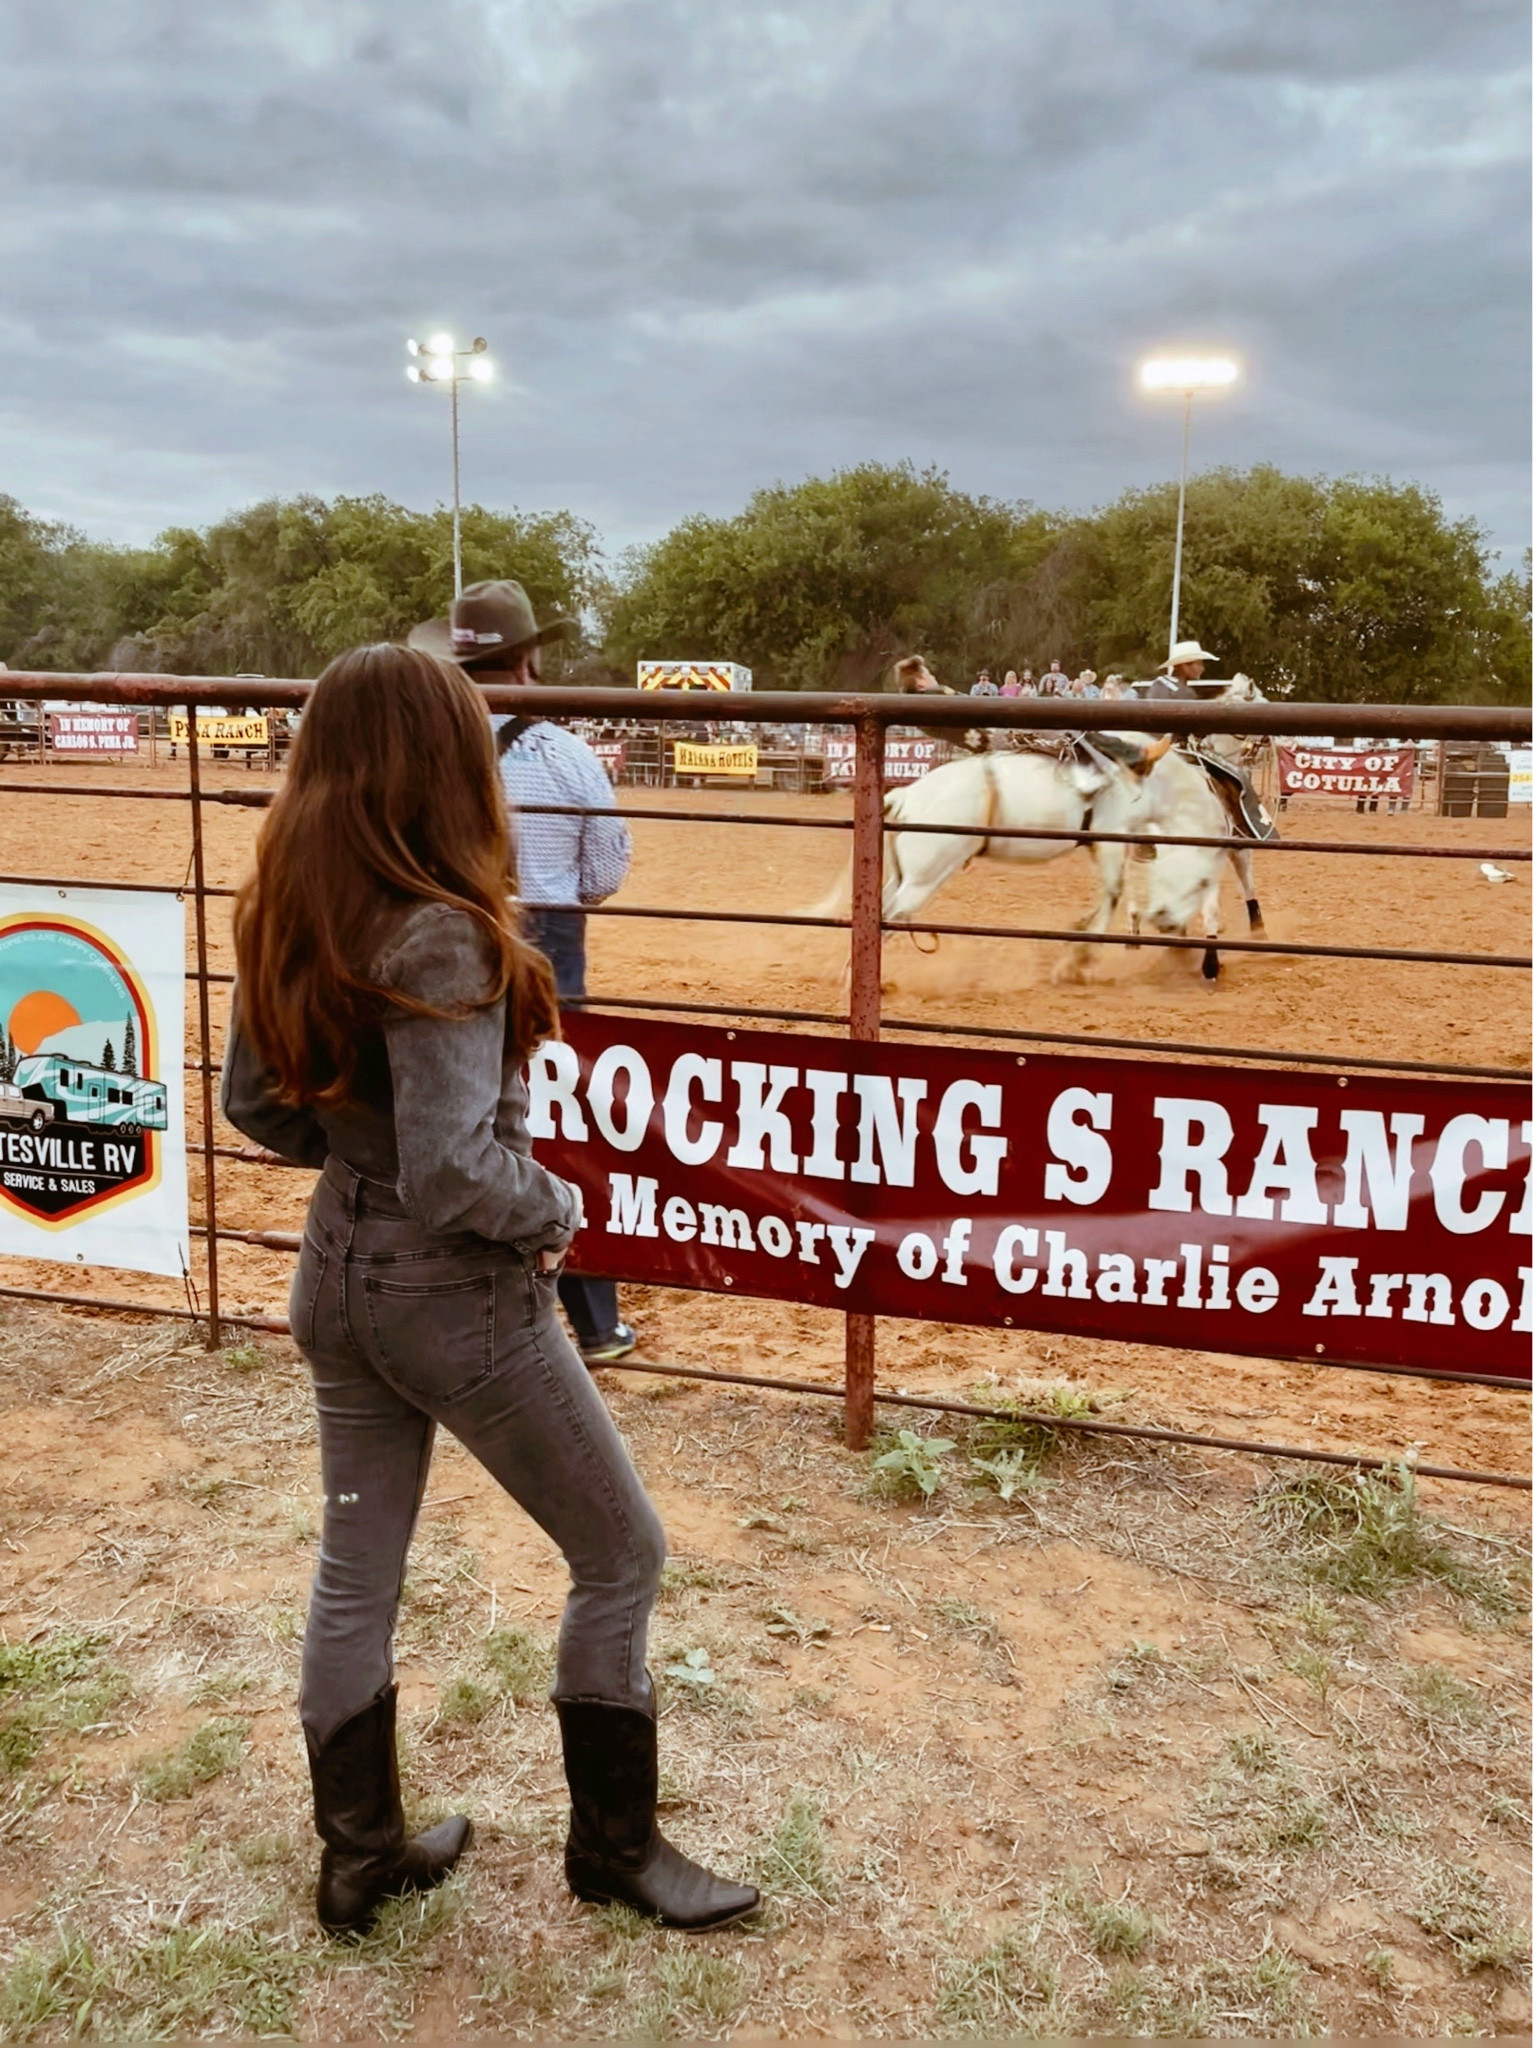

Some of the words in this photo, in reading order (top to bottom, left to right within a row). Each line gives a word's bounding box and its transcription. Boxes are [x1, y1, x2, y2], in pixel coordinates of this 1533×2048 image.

[116, 718, 130, 732] OF
[215, 722, 263, 738] RANCH
[827, 743, 843, 758] IN
[914, 743, 935, 758] OF
[1295, 752, 1357, 771] CITY
[1364, 755, 1399, 772] OF
[1286, 770, 1402, 793] COTULLA
[524, 1040, 1008, 1196] ROCKING
[1045, 1087, 1113, 1205] S
[1148, 1097, 1532, 1236] RANC
[103, 1142, 136, 1174] RV
[3, 1171, 46, 1192] SERVICE
[48, 1177, 58, 1192] &
[61, 1178, 96, 1195] SALES
[606, 1172, 877, 1289] Memory
[891, 1218, 973, 1286] of
[991, 1223, 1279, 1313] Charlie
